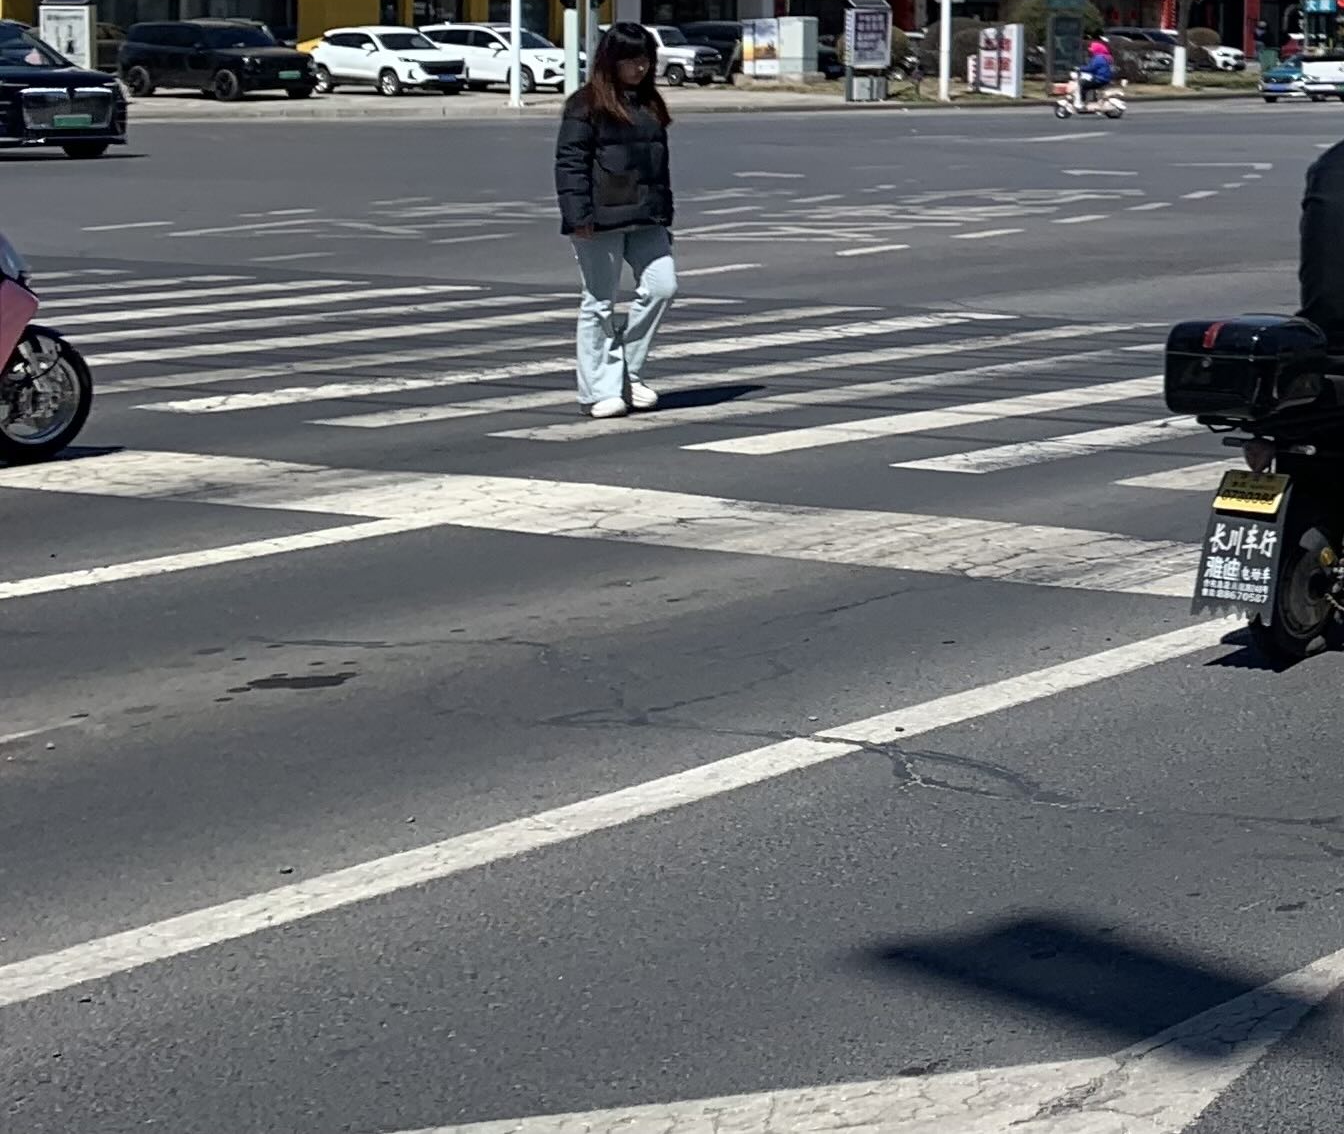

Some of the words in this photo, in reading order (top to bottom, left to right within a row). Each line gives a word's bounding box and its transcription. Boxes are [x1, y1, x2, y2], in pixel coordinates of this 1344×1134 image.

[1209, 522, 1278, 561] 长川车行
[1203, 556, 1241, 582] 雅迪
[1241, 565, 1272, 584] 电动车
